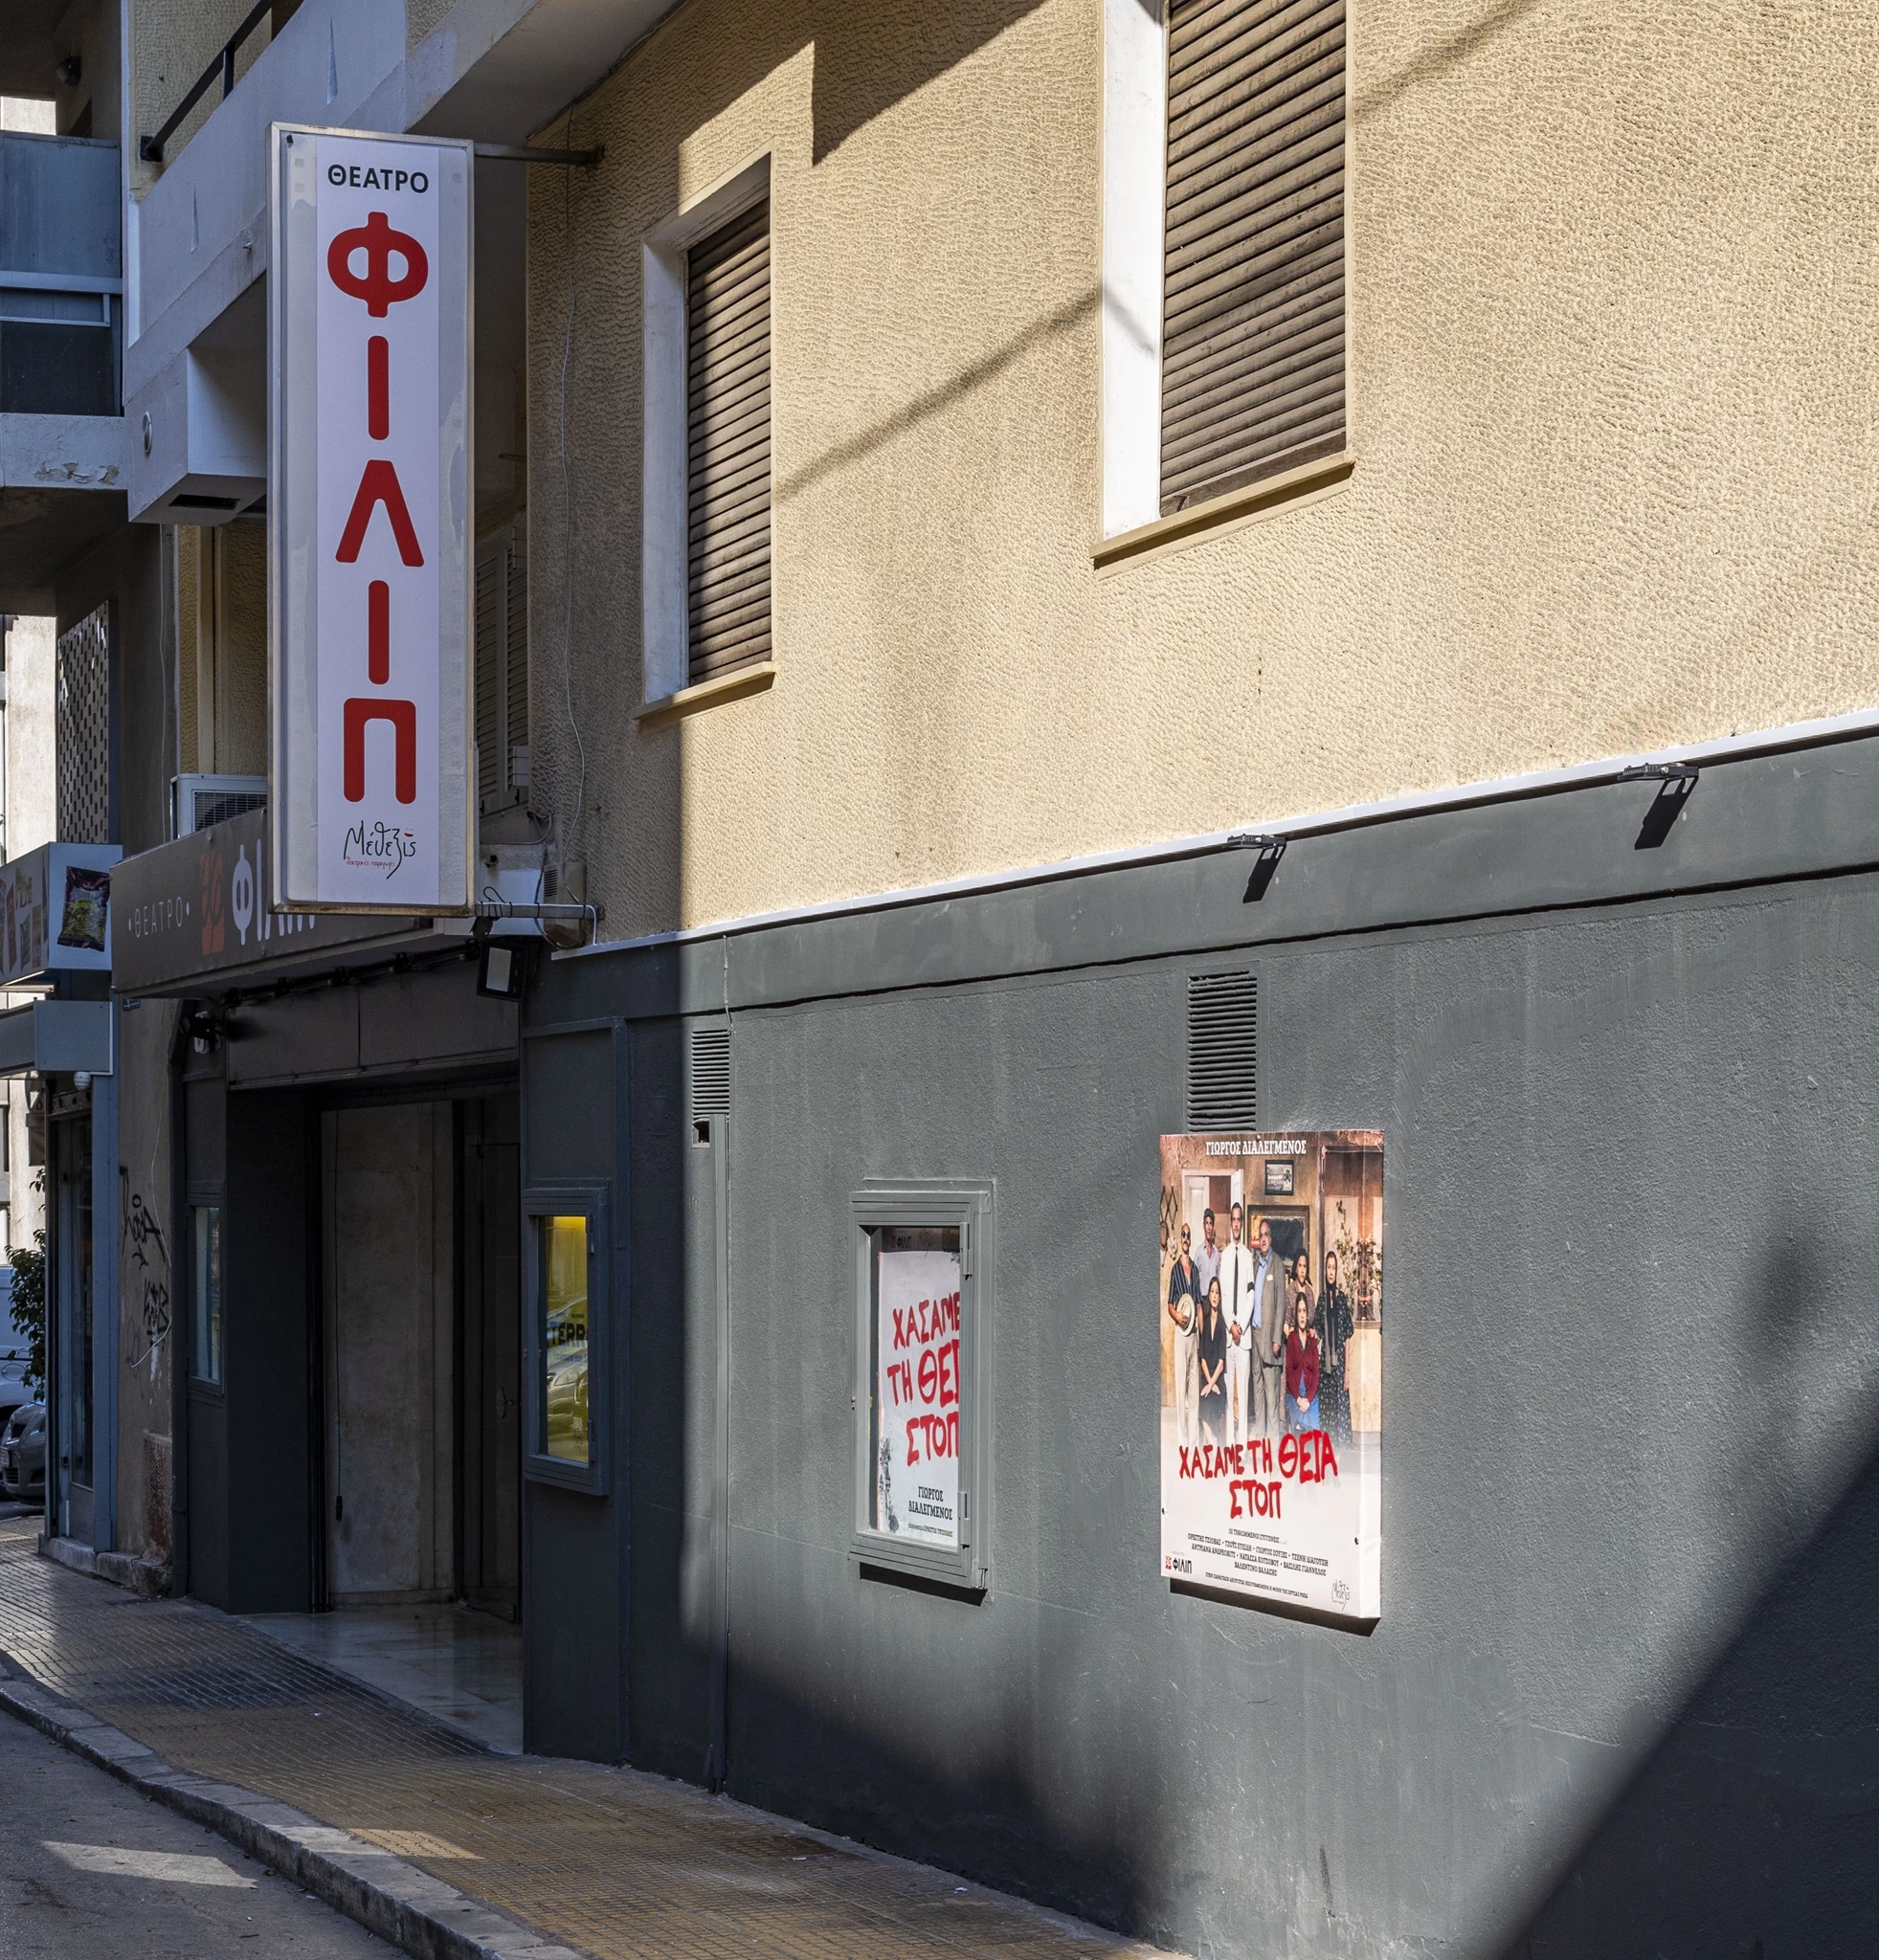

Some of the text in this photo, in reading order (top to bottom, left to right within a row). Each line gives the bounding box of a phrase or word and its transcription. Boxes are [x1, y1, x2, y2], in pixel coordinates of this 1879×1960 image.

[327, 164, 430, 194] ΘΕΑΤΡΟ
[326, 211, 429, 805] ΦΙΛΙΠ
[133, 896, 184, 938] ΘΕΑΤΡΟ
[1205, 1139, 1307, 1156] ΓΙΩΡΓΟΣ ΔΙΑΛΕΓΜΕΝΟΣ
[550, 1321, 589, 1348] TERR
[892, 1291, 960, 1351] ΧΑΣΑΜΕ
[886, 1338, 960, 1409] ΤΗ ΘΕΙ
[906, 1410, 960, 1467] ΣΤΟΠ
[1178, 1429, 1339, 1484] ΧΑΣΑΜΕ ΤΗ ΘΕΙΑ
[907, 1500, 953, 1521] ΔΙΑΛΕΓΜΕΝΟΣ
[917, 1485, 944, 1503] ΓΙΩΡΓΟΣ
[1229, 1479, 1283, 1520] ΣΤΟΠ
[1172, 1557, 1193, 1574] ΦΙΛΙΠ
